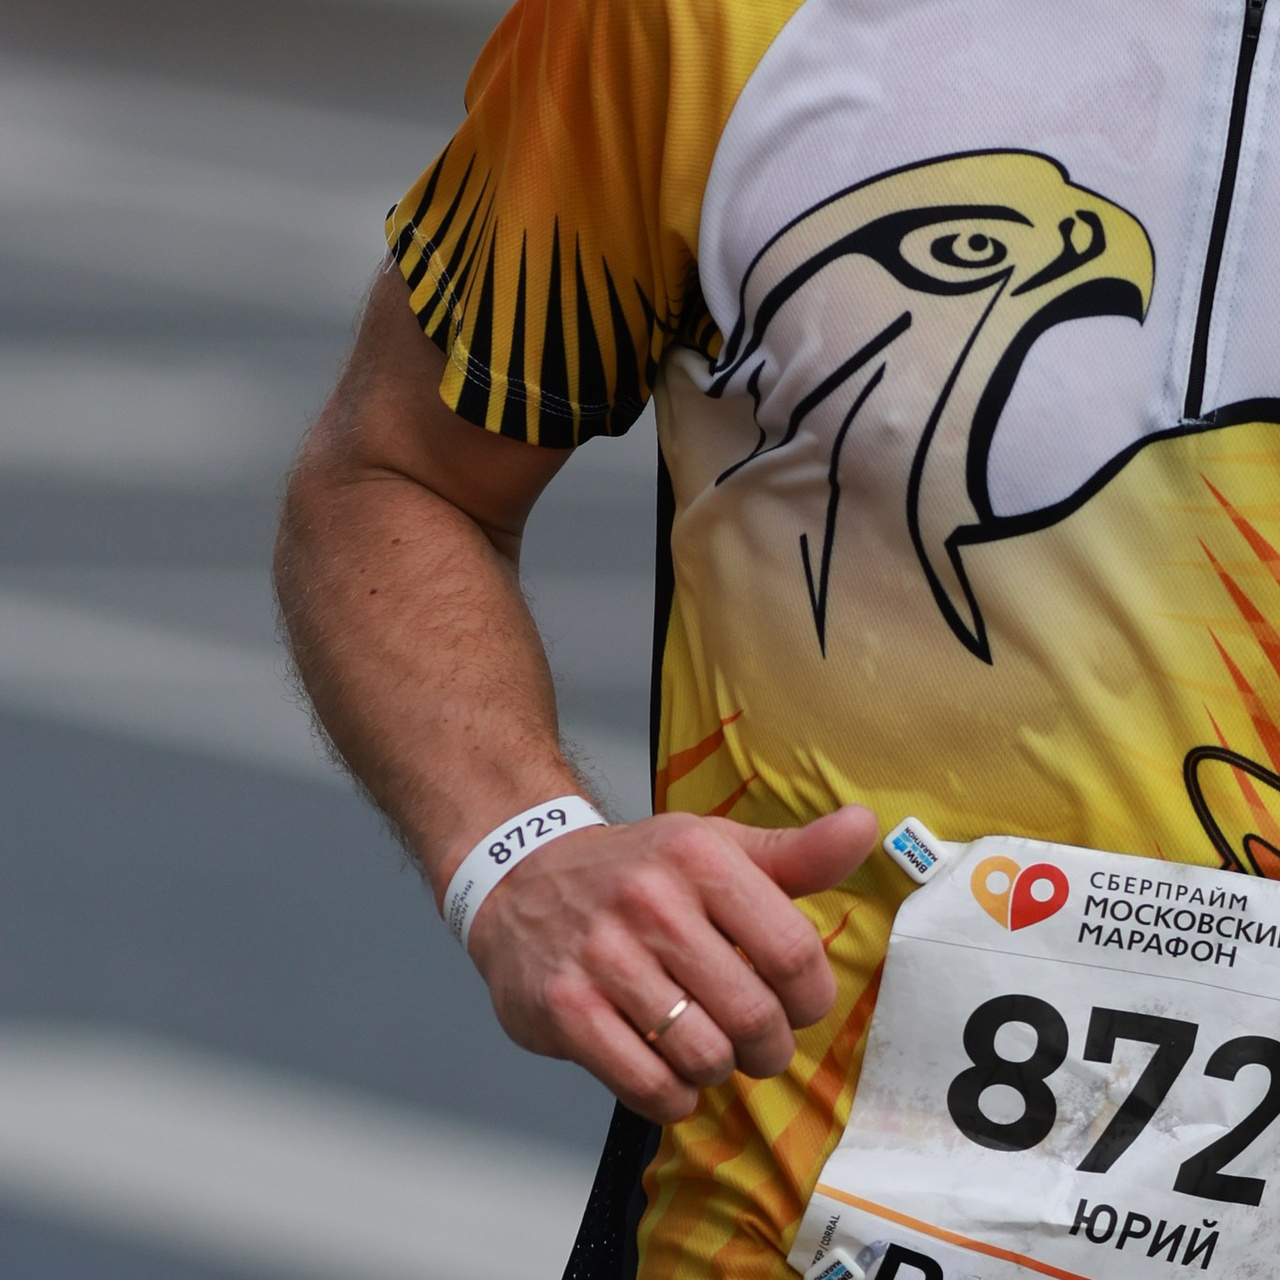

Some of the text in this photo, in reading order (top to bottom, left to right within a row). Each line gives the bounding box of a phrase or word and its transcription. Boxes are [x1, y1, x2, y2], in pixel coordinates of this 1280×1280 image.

[488, 808, 567, 865] 8729
[904, 827, 938, 862] MARATHON
[911, 843, 933, 867] BERLIN
[903, 850, 928, 874] BMW
[1090, 871, 1248, 912] СБЕРПРАЙМ
[1077, 922, 1237, 968] МАРАФОН
[821, 1215, 841, 1247] CORRAL
[1068, 1198, 1220, 1270] ЮРИЙ
